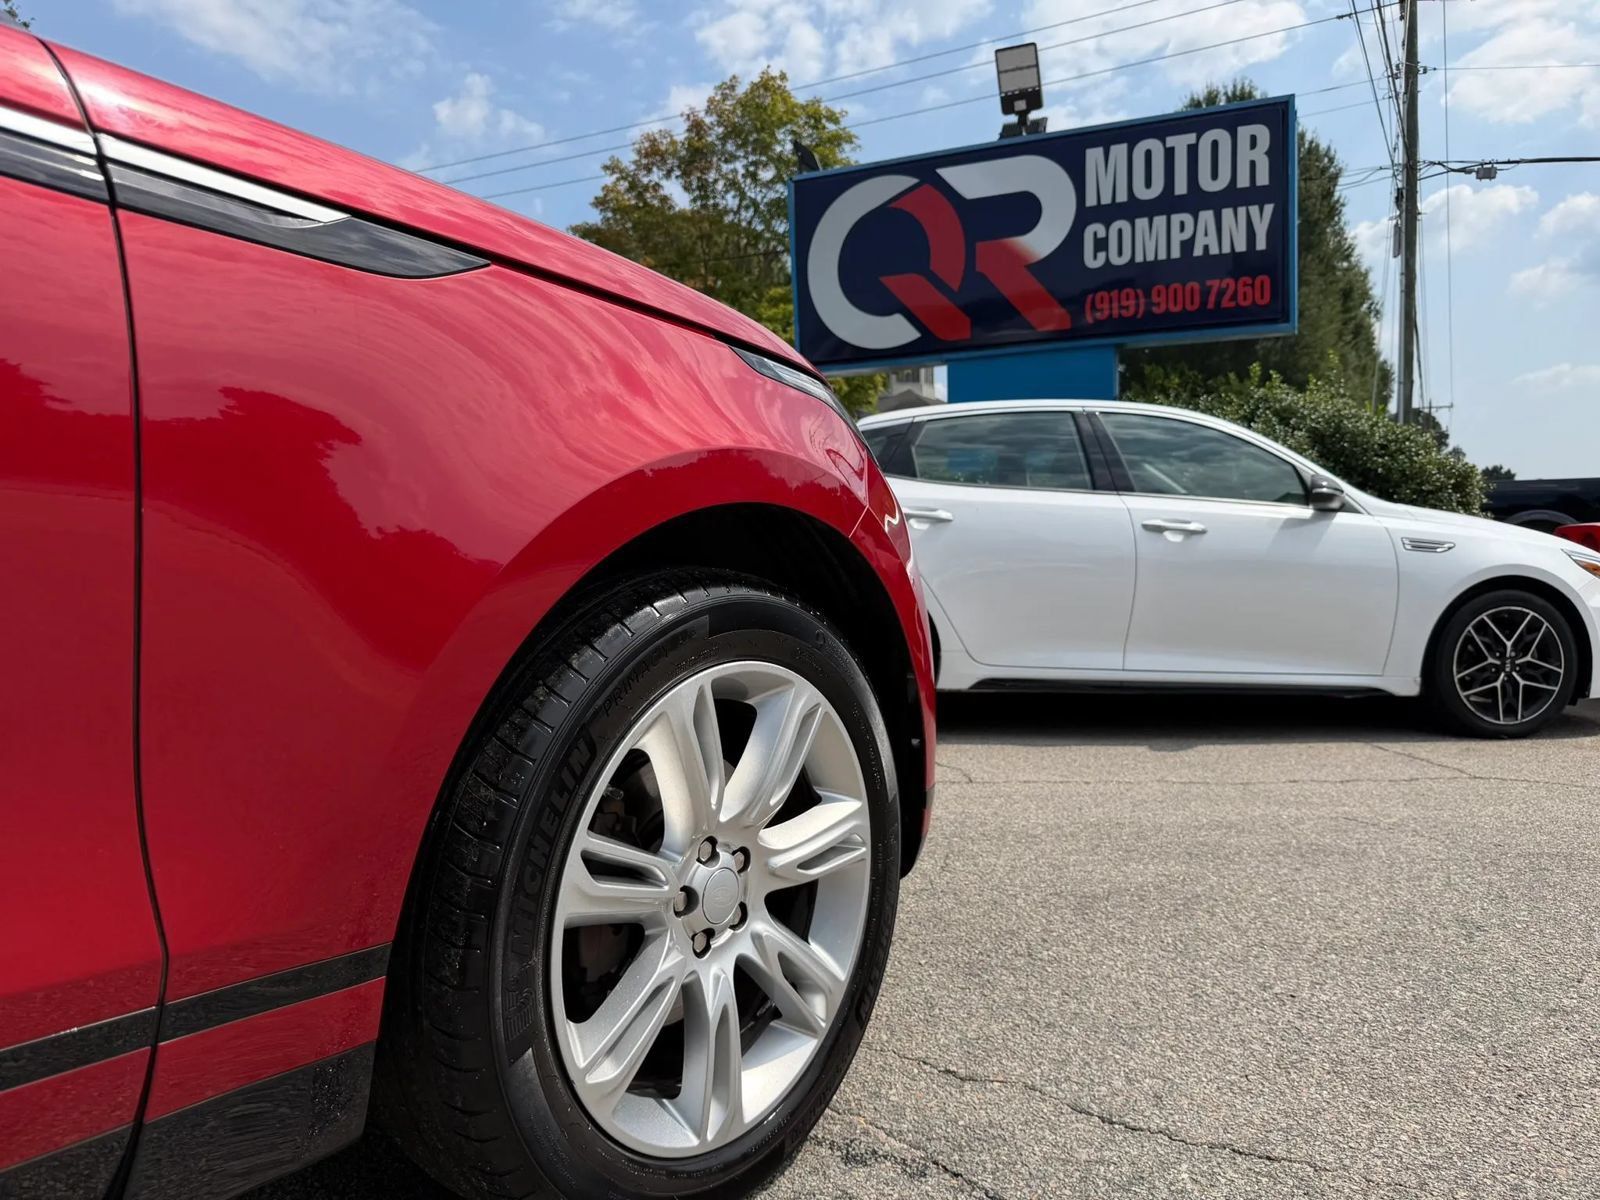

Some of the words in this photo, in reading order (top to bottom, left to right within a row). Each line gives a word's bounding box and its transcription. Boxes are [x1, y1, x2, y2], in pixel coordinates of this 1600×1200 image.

[1085, 124, 1270, 207] MOTOR
[1083, 203, 1275, 269] COMPANY
[1085, 288, 1145, 324] (919)
[1151, 281, 1201, 315] 900
[1206, 275, 1271, 310] 7260
[509, 734, 593, 958] MICHELIN
